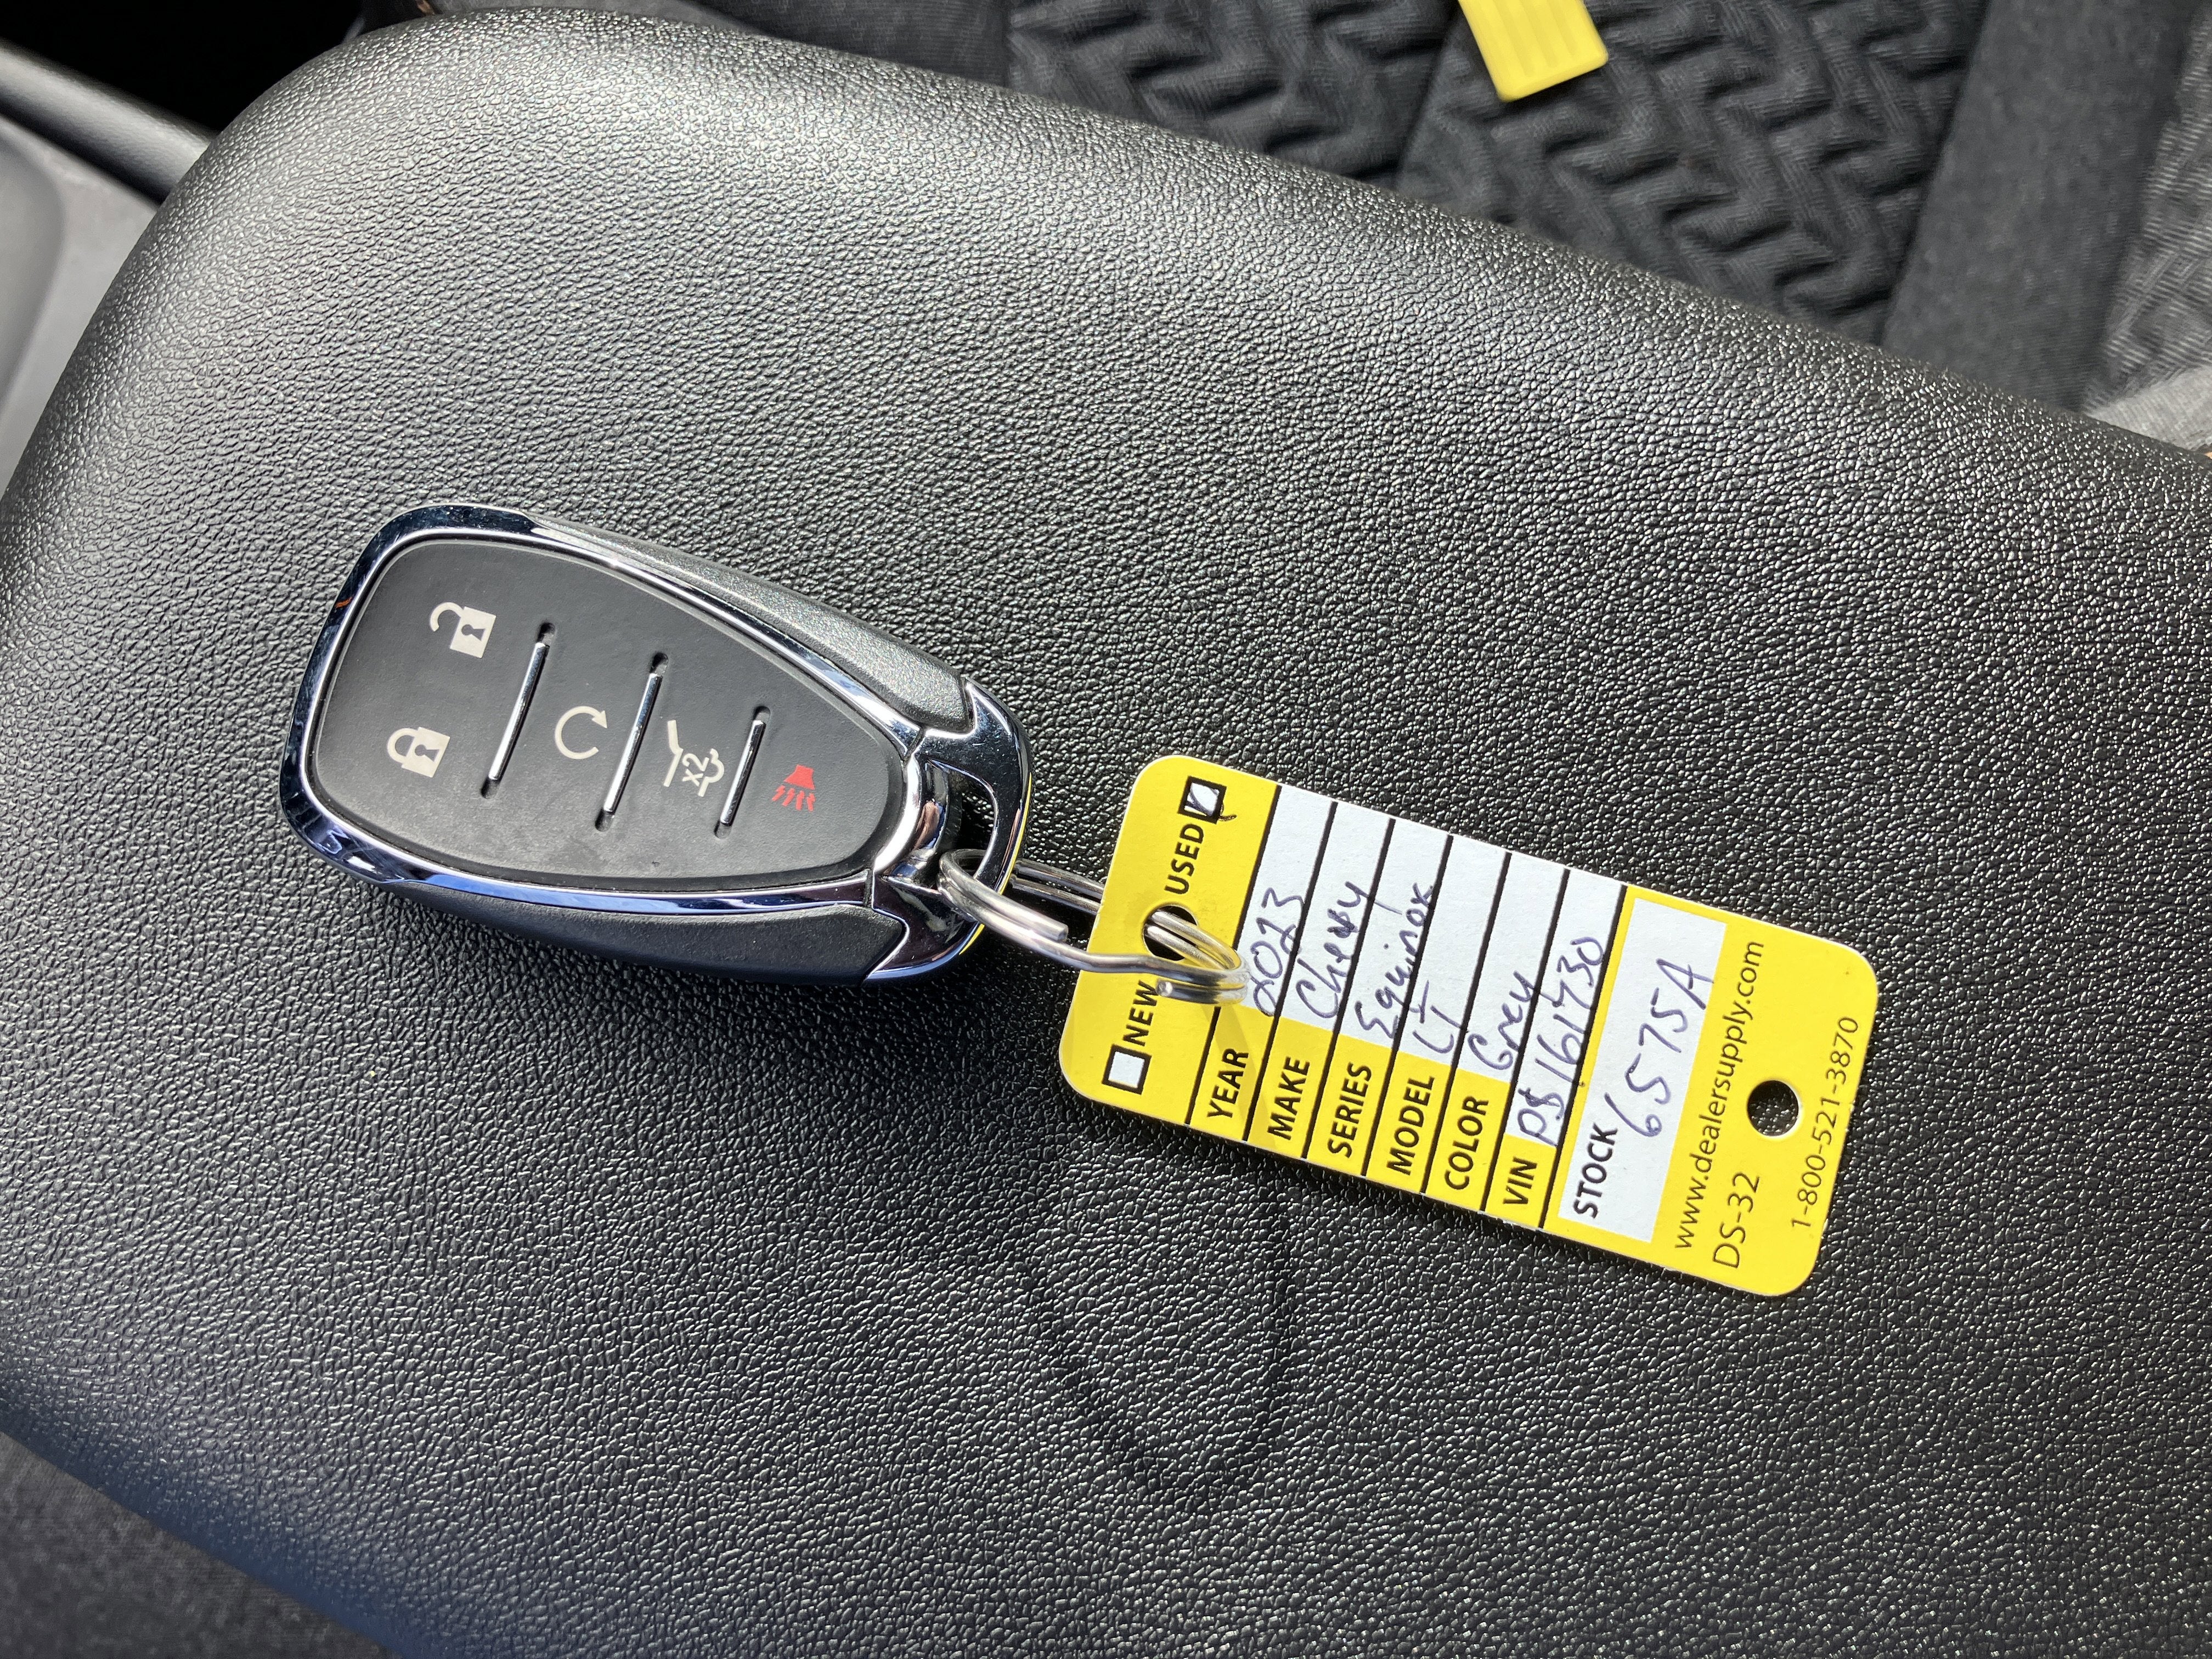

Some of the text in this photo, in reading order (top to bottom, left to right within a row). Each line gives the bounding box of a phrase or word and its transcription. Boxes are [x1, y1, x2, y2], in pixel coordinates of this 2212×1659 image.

[1123, 823, 1204, 1047] NEW USED
[1296, 881, 1402, 1019] Chevy
[1355, 882, 1434, 1039] Equinox
[1413, 980, 1469, 1054] LT
[1467, 970, 1558, 1070] Grey
[1604, 958, 1714, 1137] 6575A
[1207, 1048, 1249, 1118] YEAR
[1267, 1057, 1310, 1141] MAKE
[1329, 1062, 1372, 1159] SERIES
[1387, 1076, 1435, 1176] MODEL
[1675, 941, 1764, 1249] www.dealersupply.com
[1791, 1017, 1859, 1229] 1-800-521-3870
[1444, 1095, 1489, 1190] COLOR
[1503, 1157, 1538, 1205] VIN
[1573, 1123, 1618, 1218] STOCK
[1713, 1172, 1759, 1269] DS-32
